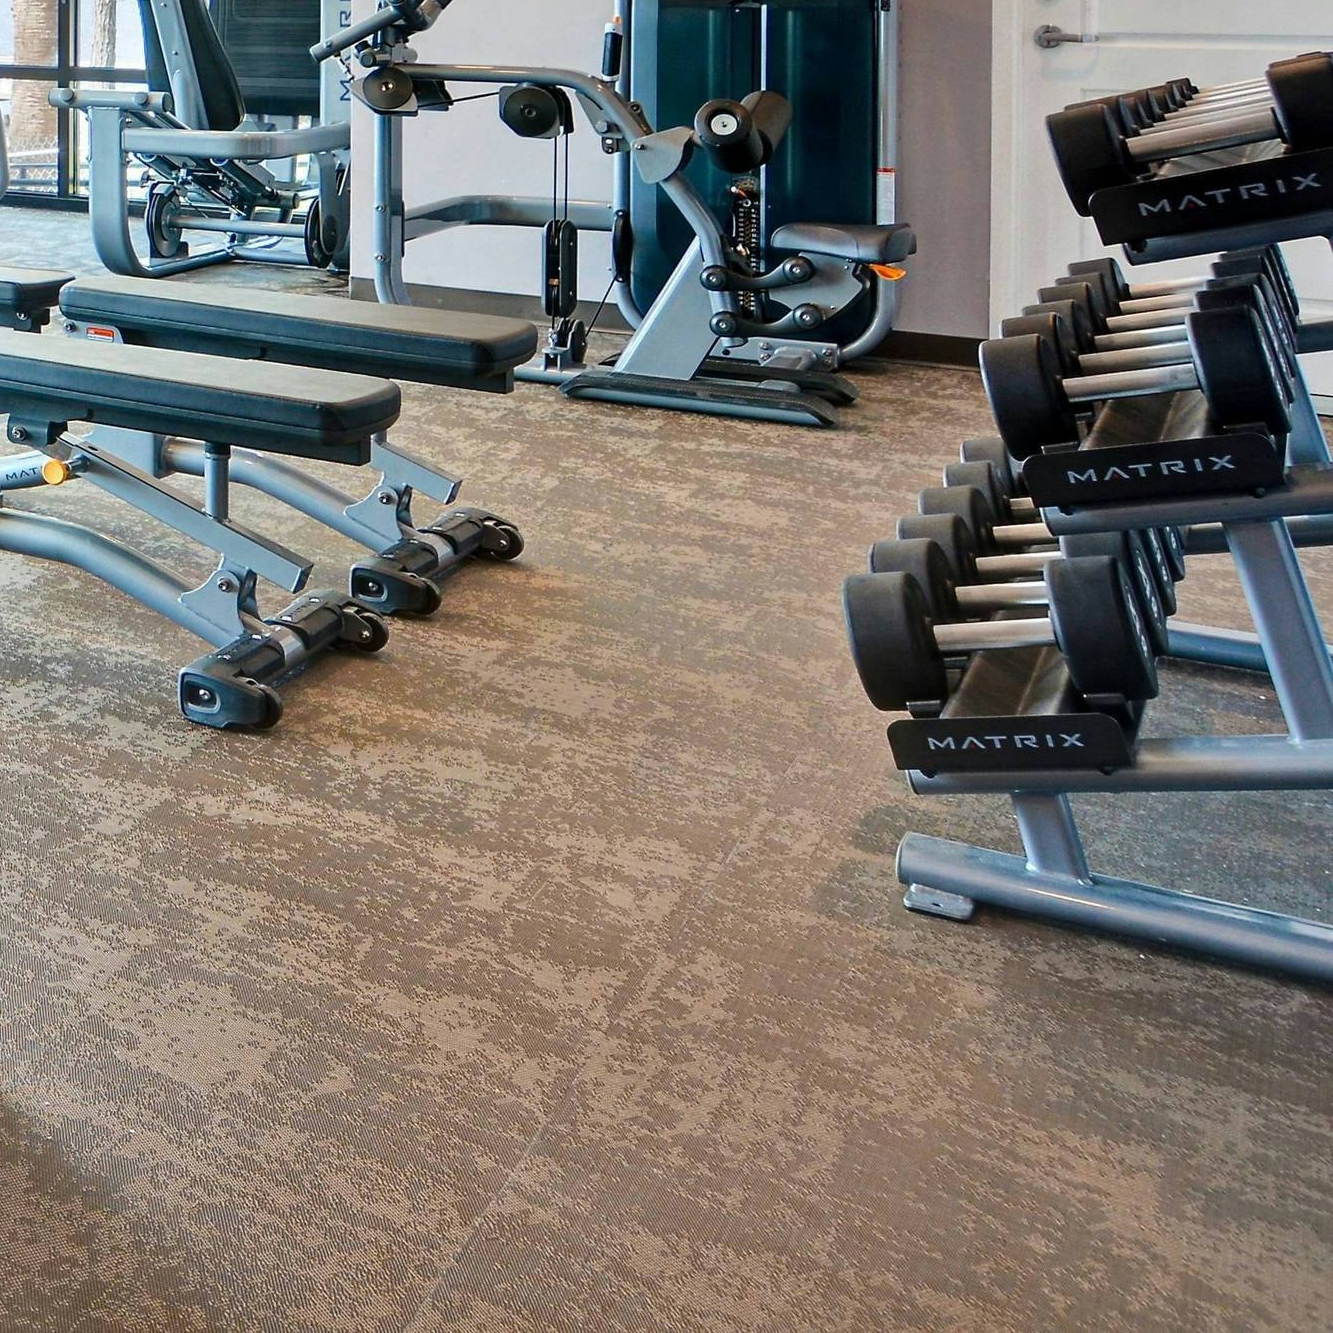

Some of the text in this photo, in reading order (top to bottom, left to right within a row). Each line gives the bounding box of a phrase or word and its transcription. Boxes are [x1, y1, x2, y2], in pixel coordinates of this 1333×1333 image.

[1137, 172, 1322, 216] MATRIX
[5, 466, 38, 481] MAT
[1066, 455, 1235, 484] MATRIX
[927, 733, 1085, 750] MATRIX
